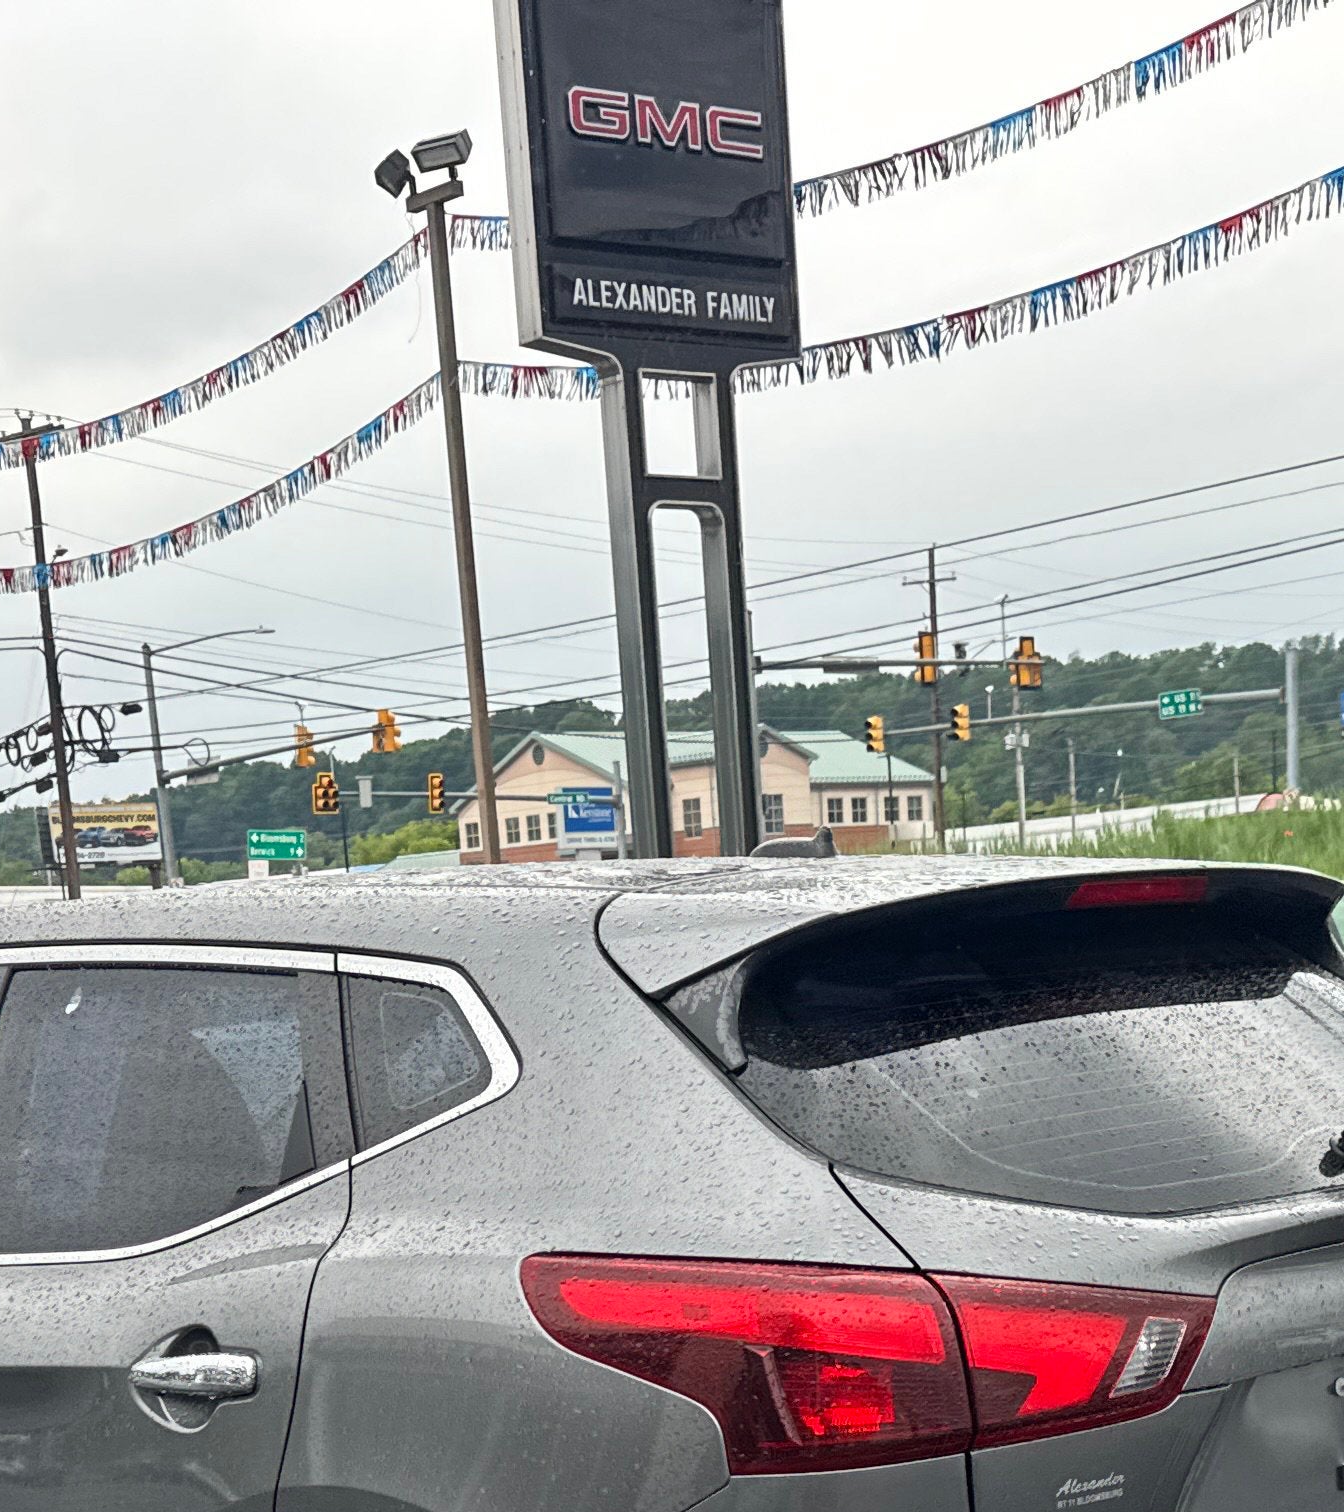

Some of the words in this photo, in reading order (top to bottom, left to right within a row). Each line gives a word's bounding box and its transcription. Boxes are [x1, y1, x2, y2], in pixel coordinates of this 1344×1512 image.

[567, 85, 763, 159] GMC
[572, 277, 697, 317] ALEXANDER
[706, 290, 775, 323] FAMILY
[1056, 1471, 1126, 1498] Alexander
